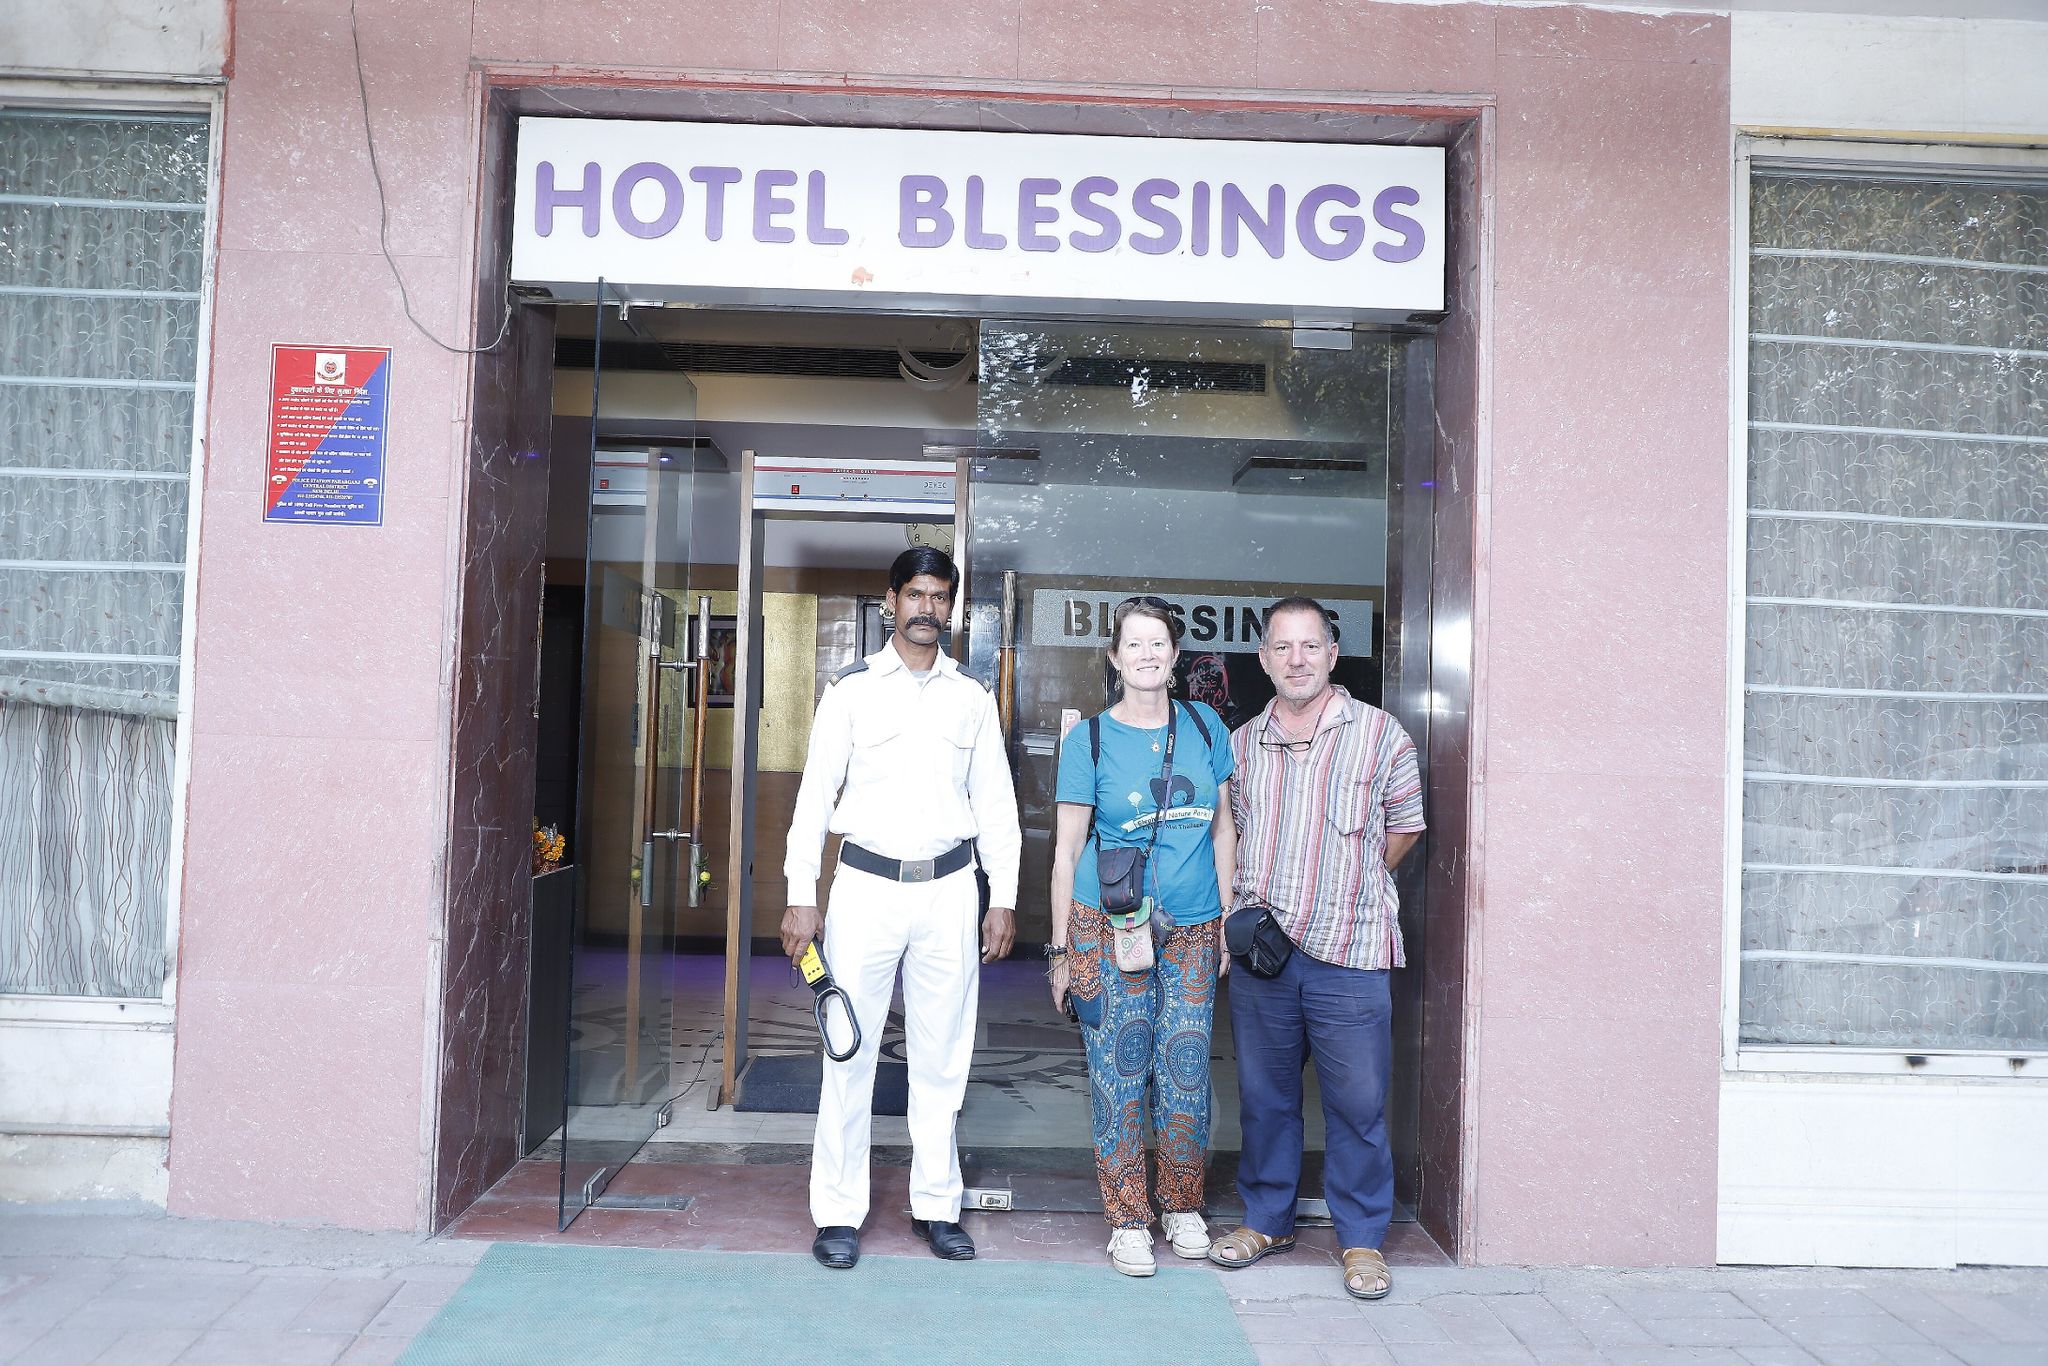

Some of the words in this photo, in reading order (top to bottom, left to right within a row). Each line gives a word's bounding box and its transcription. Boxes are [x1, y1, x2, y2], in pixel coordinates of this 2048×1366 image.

[535, 160, 850, 245] HOTEL
[899, 174, 1426, 263] BLESSINGS
[914, 533, 920, 543] 8
[1064, 599, 1341, 645] BLSSINS
